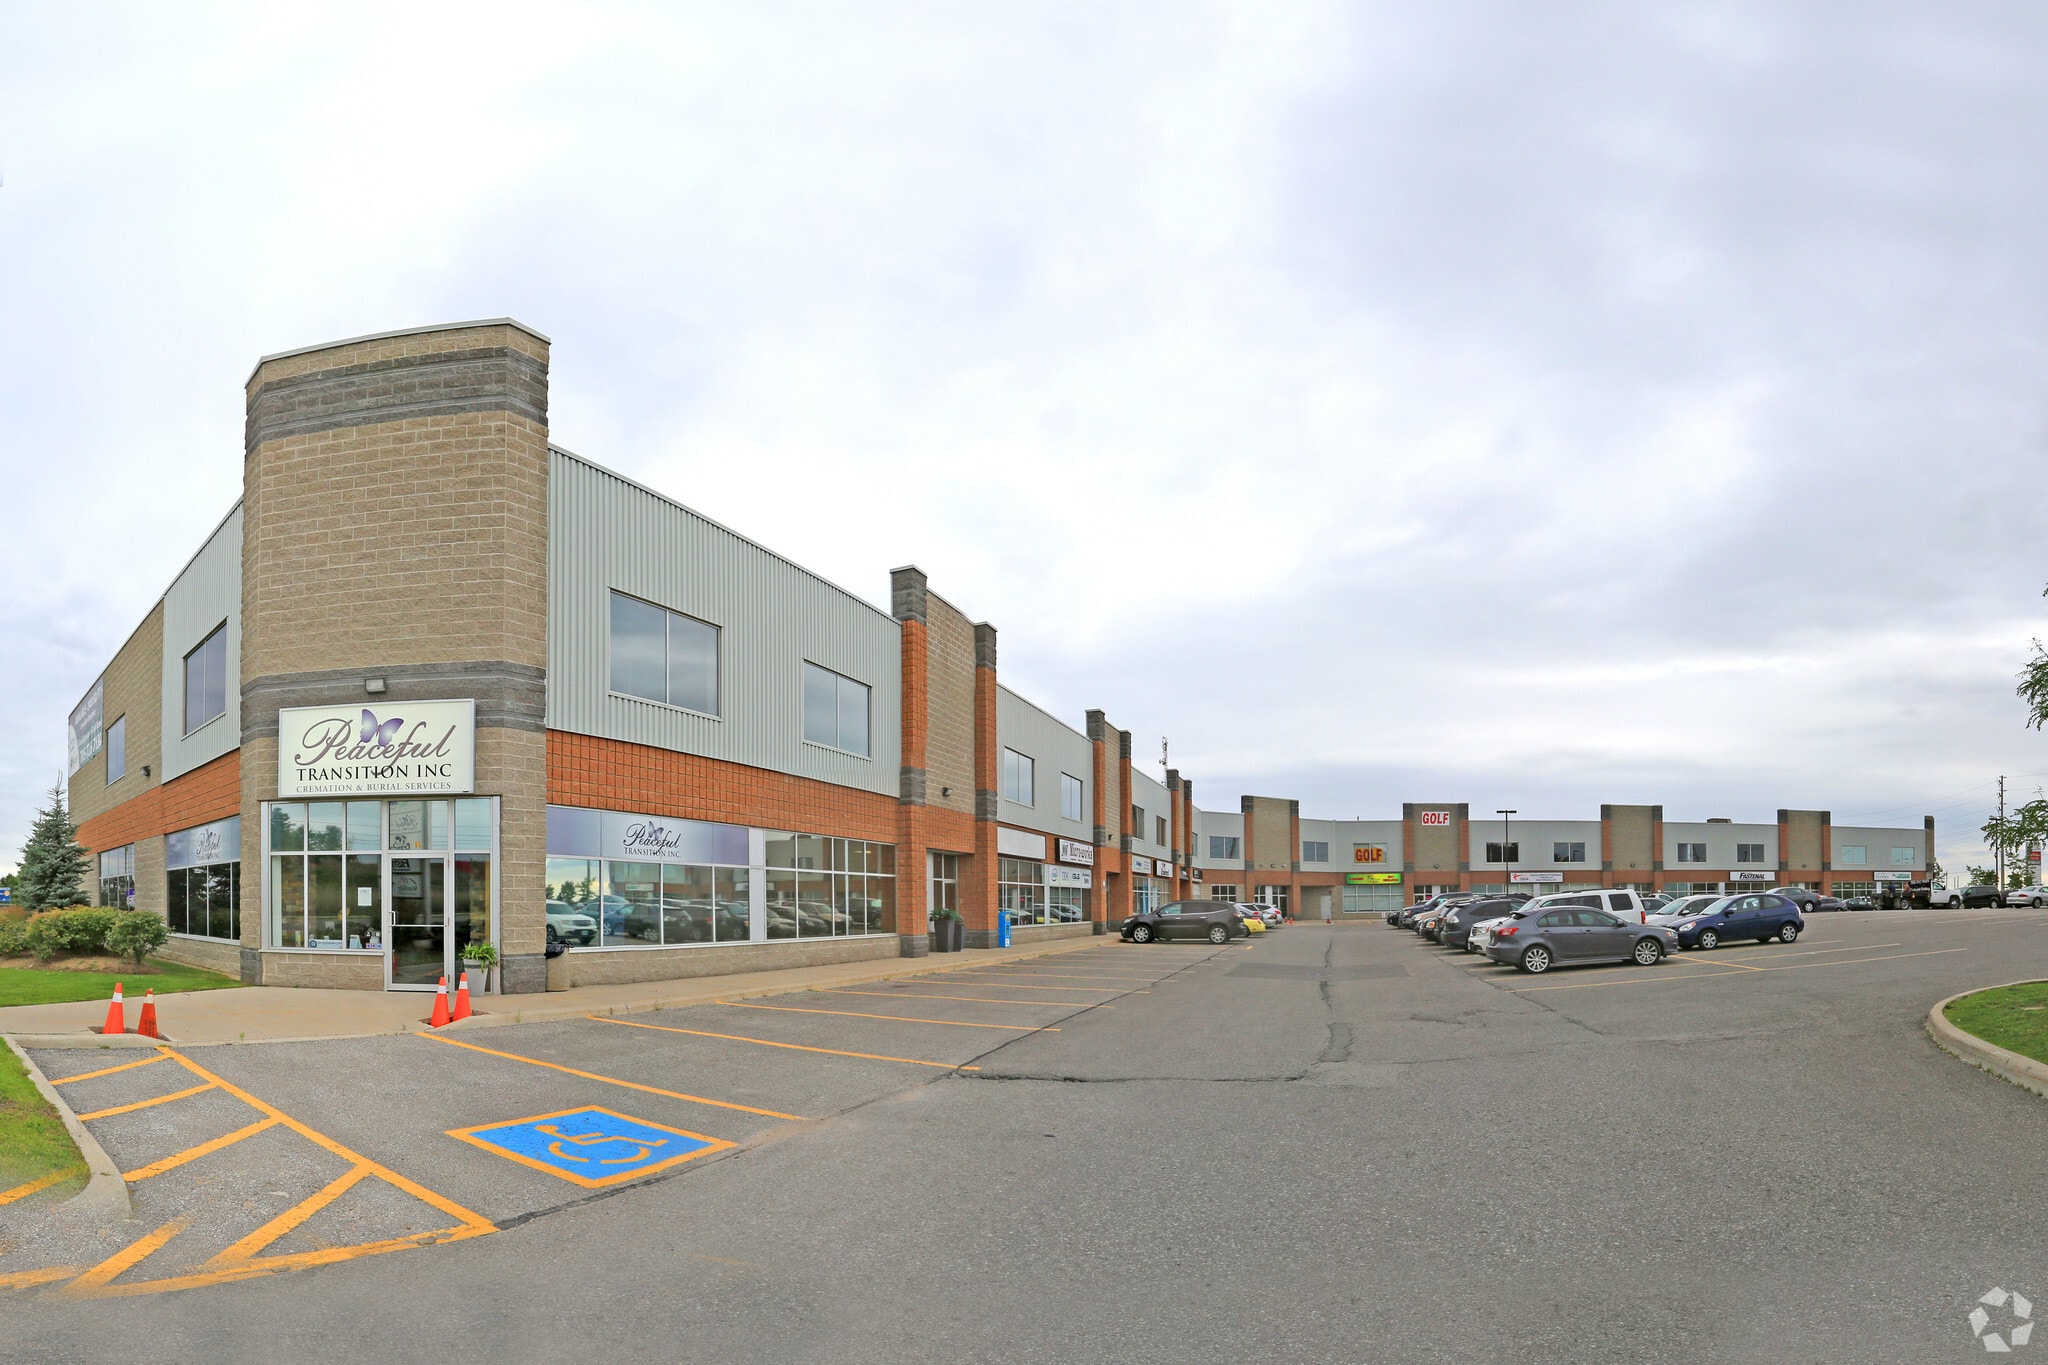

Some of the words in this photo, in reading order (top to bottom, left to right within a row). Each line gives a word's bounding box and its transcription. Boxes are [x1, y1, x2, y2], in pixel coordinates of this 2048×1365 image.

[294, 718, 457, 776] Peaceful
[296, 765, 408, 781] TRANSITION
[417, 763, 452, 778] INC
[296, 784, 353, 793] CREMATION
[367, 782, 402, 791] BURIAL
[405, 781, 452, 790] SERVICES
[1422, 812, 1449, 825] GOLF
[623, 823, 682, 855] Peaceful
[624, 847, 666, 857] TRANSITION
[1355, 848, 1383, 862] GOLF
[1739, 872, 1766, 880] FASTENAL
